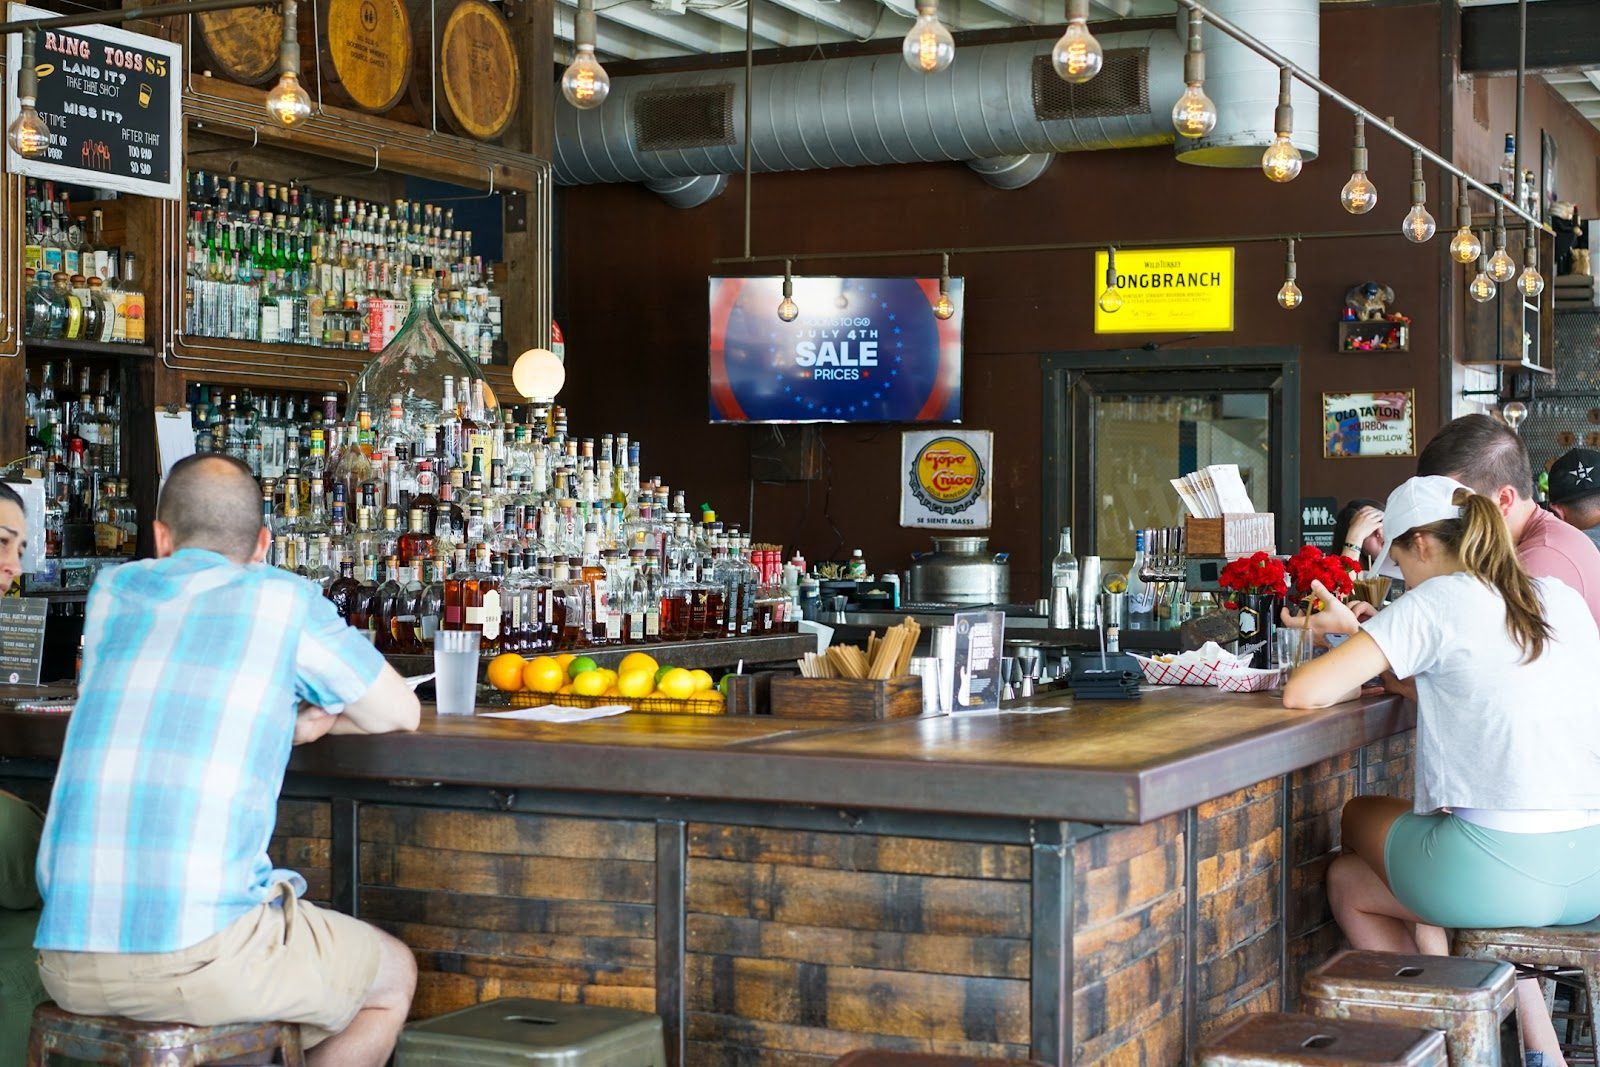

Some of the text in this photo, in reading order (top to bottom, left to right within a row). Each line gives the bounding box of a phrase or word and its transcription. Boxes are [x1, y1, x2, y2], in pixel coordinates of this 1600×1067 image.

[45, 32, 167, 77] RING TOSS $5
[62, 60, 126, 85] LAND IT?
[66, 75, 119, 97] TAKE THAT SHOT
[50, 113, 66, 128] TIME
[63, 101, 123, 124] MISS IT?
[122, 128, 160, 146] AFTER THAT
[128, 145, 152, 160] TOO BAD
[130, 161, 151, 175] SO SAD
[1116, 272, 1220, 288] ONGBRANCH
[796, 330, 878, 340] JULY 4TH
[796, 341, 878, 366] SALE
[814, 368, 860, 380] PRICES
[1335, 406, 1400, 422] OLD TAYLOR
[1373, 434, 1403, 442] MELLOW
